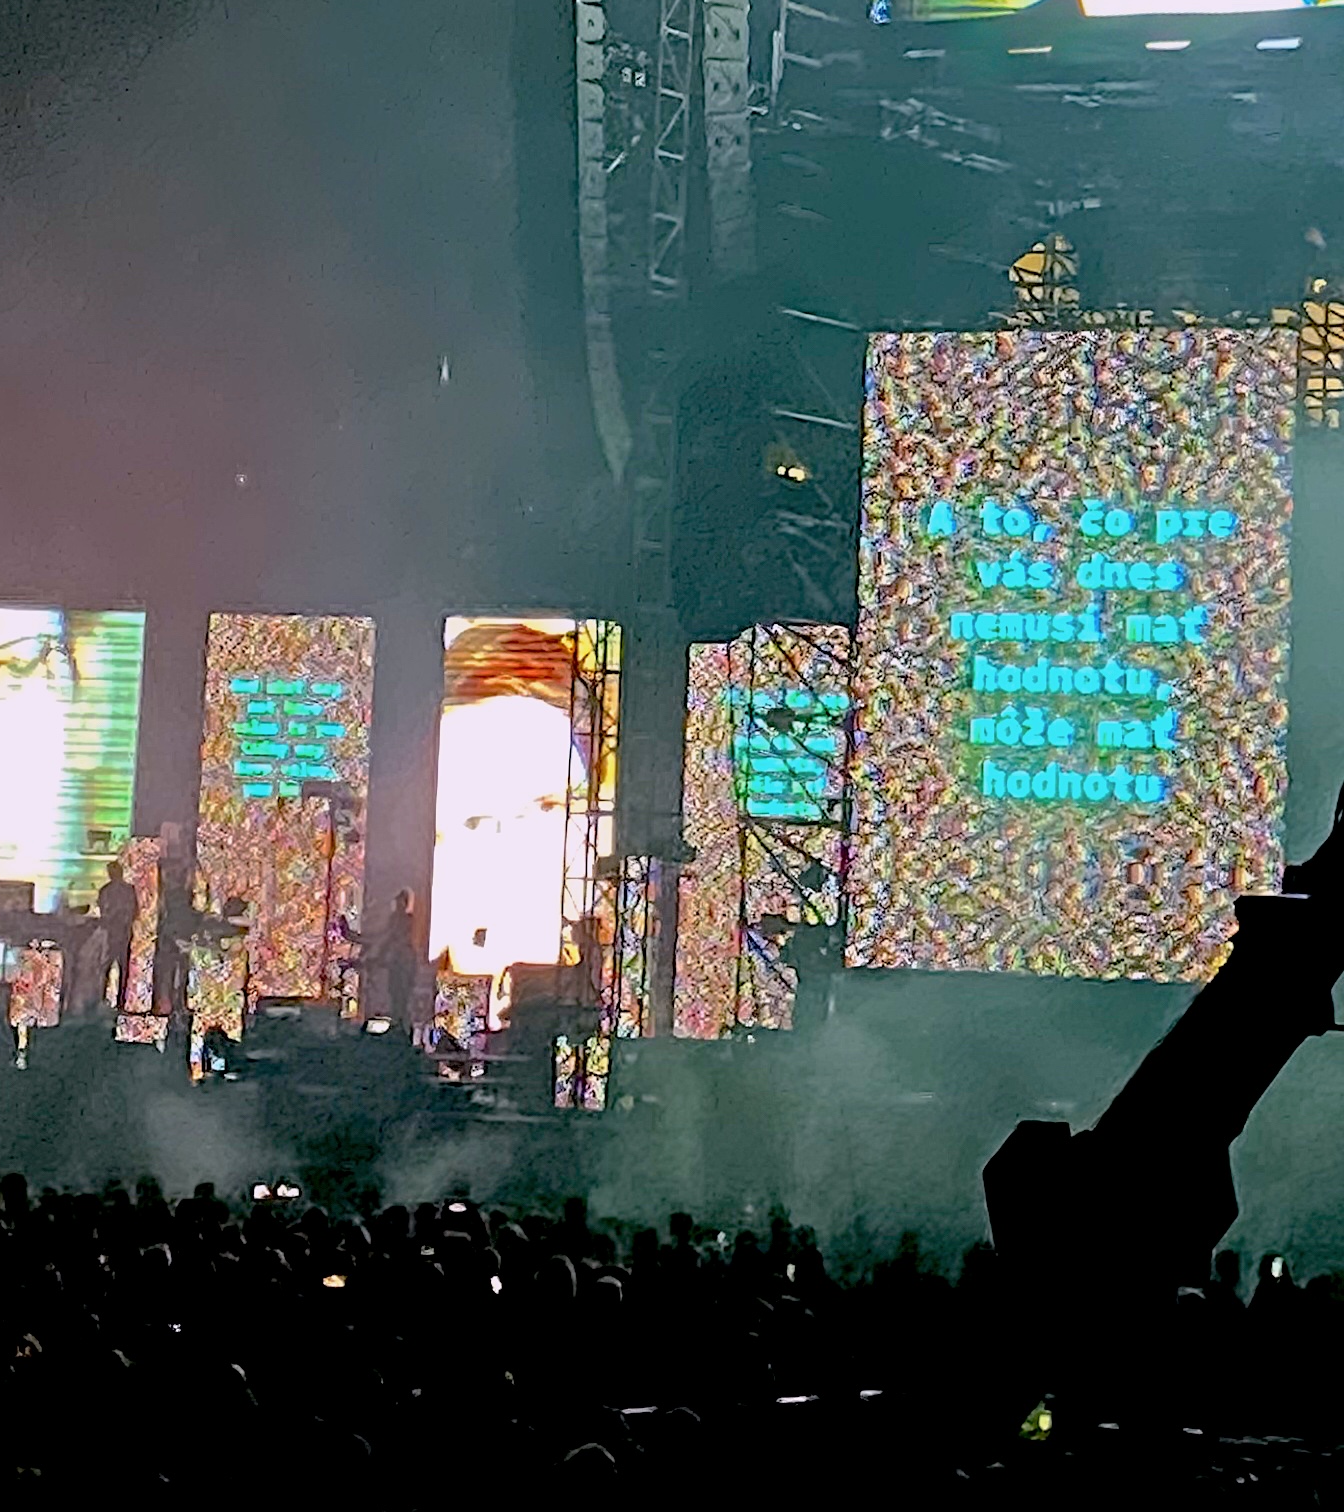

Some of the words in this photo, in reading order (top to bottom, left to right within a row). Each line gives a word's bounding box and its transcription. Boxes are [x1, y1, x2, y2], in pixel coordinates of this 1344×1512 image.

[927, 500, 956, 536] A
[980, 500, 1054, 543] to,
[1079, 498, 1136, 537] čo
[1155, 510, 1239, 545] pre
[976, 550, 1055, 589] vás
[1076, 552, 1186, 590] dnes
[950, 603, 1103, 642] nemusí
[973, 655, 1173, 703] hodnotu,
[983, 757, 1168, 804] hodnotu
